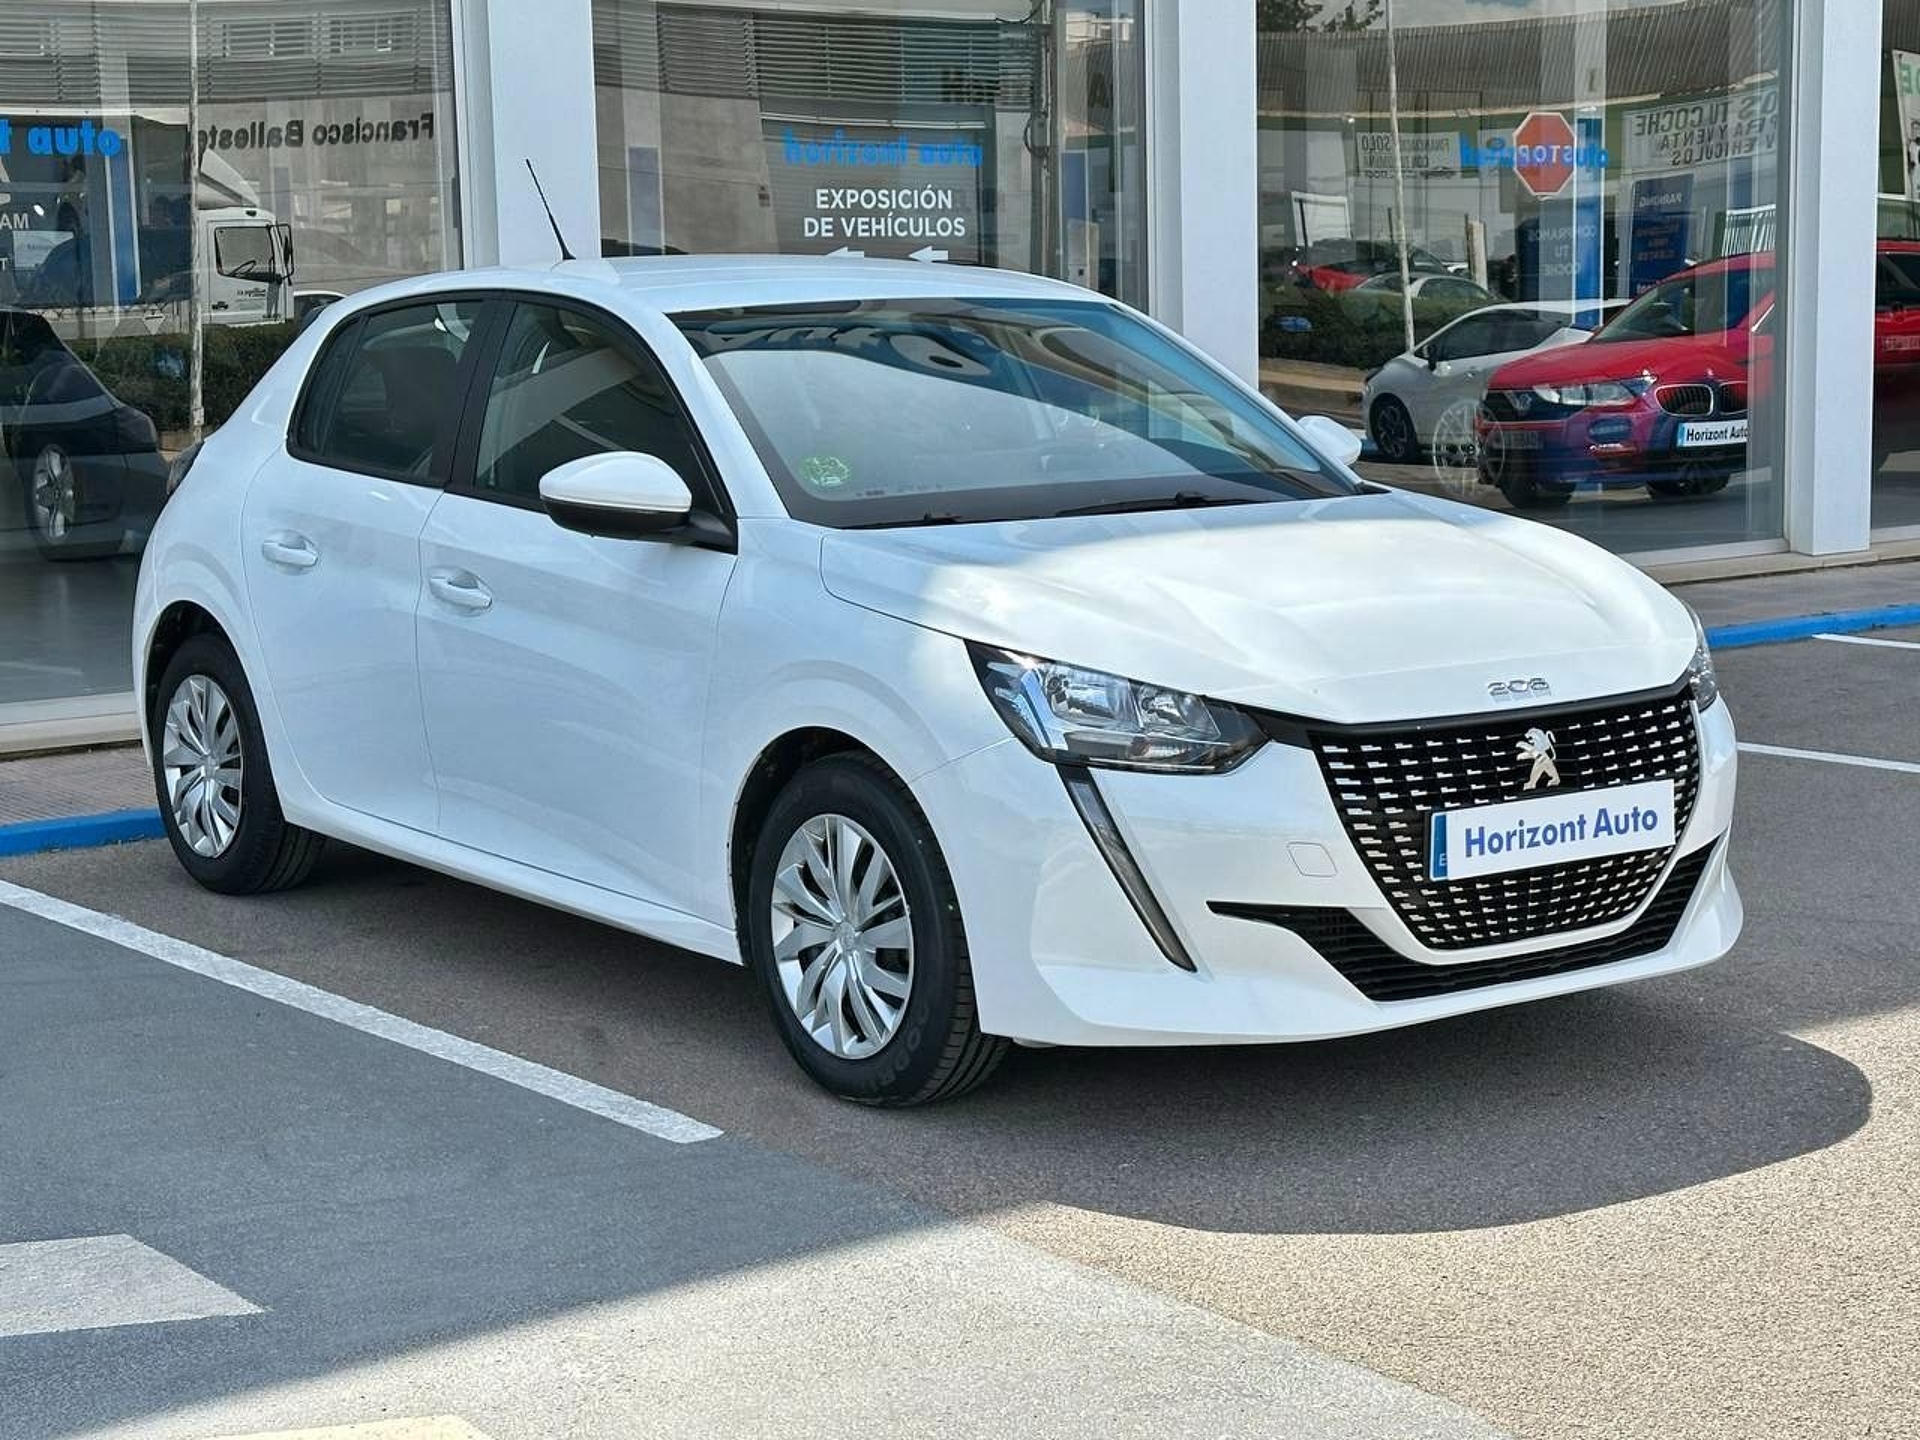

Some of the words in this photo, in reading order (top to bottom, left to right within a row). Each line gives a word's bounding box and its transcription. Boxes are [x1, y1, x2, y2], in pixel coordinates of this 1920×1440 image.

[27, 119, 122, 156] auto
[815, 184, 953, 210] EXPOSICIÓN
[803, 217, 834, 238] DE
[842, 212, 966, 238] VEHÍCULOS
[1686, 427, 1729, 442] Horizont
[1487, 676, 1550, 697] 208
[1464, 813, 1587, 859] Horizont
[1594, 807, 1659, 837] Auto
